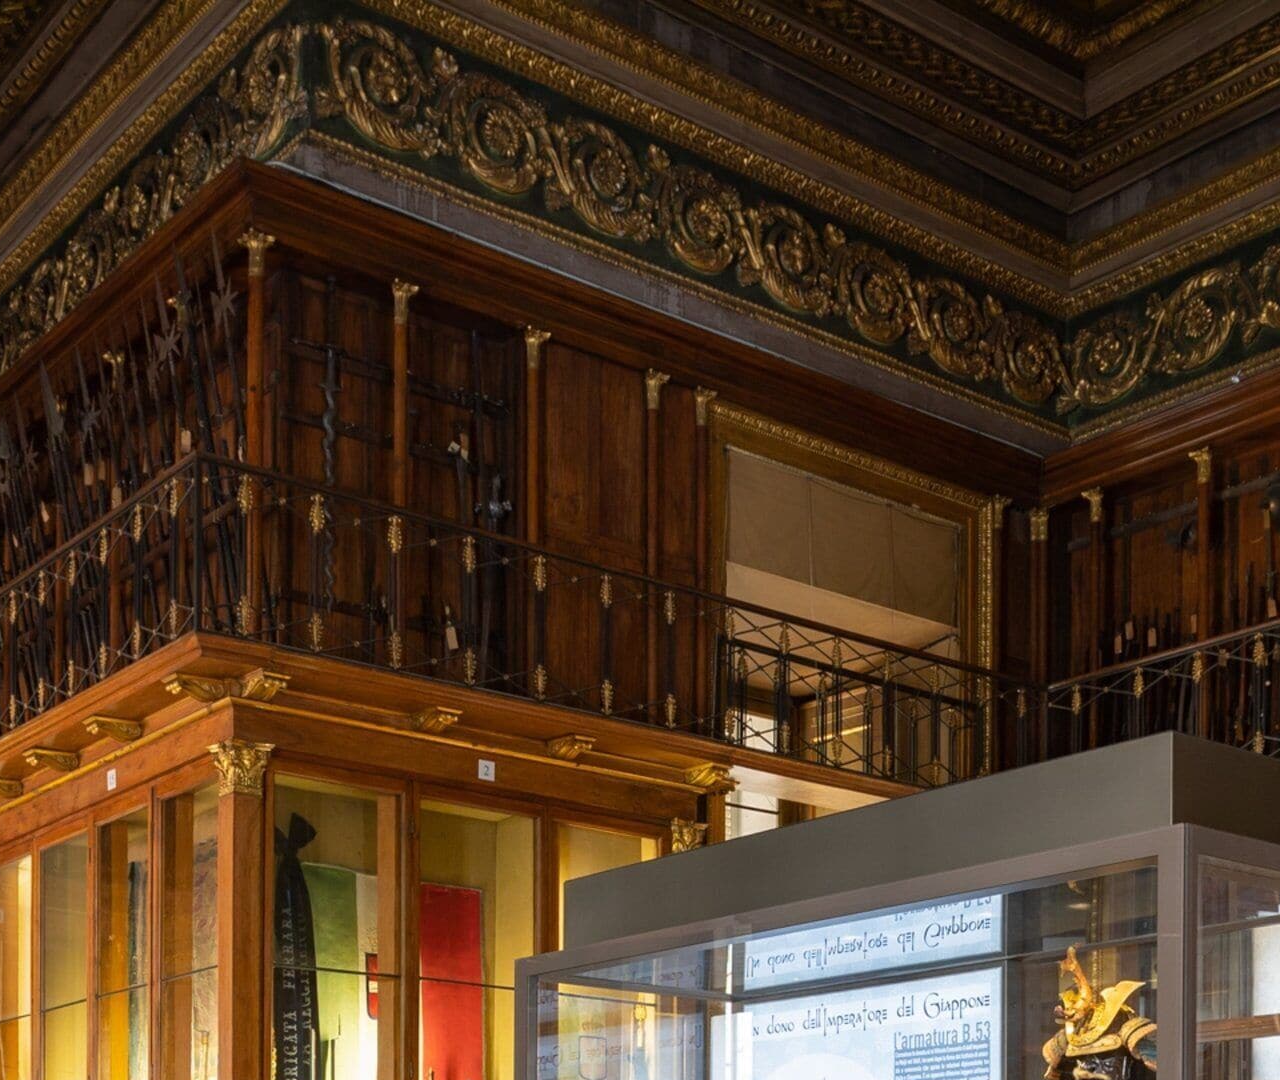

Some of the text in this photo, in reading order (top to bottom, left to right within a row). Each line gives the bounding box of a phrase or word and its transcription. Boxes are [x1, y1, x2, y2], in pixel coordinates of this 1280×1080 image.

[483, 764, 490, 776] 2
[281, 906, 296, 989] FERRARA
[766, 1014, 795, 1035] dono
[896, 995, 914, 1018] del
[923, 991, 991, 1019] Giappone
[894, 1021, 991, 1050] L'armatura B.53
